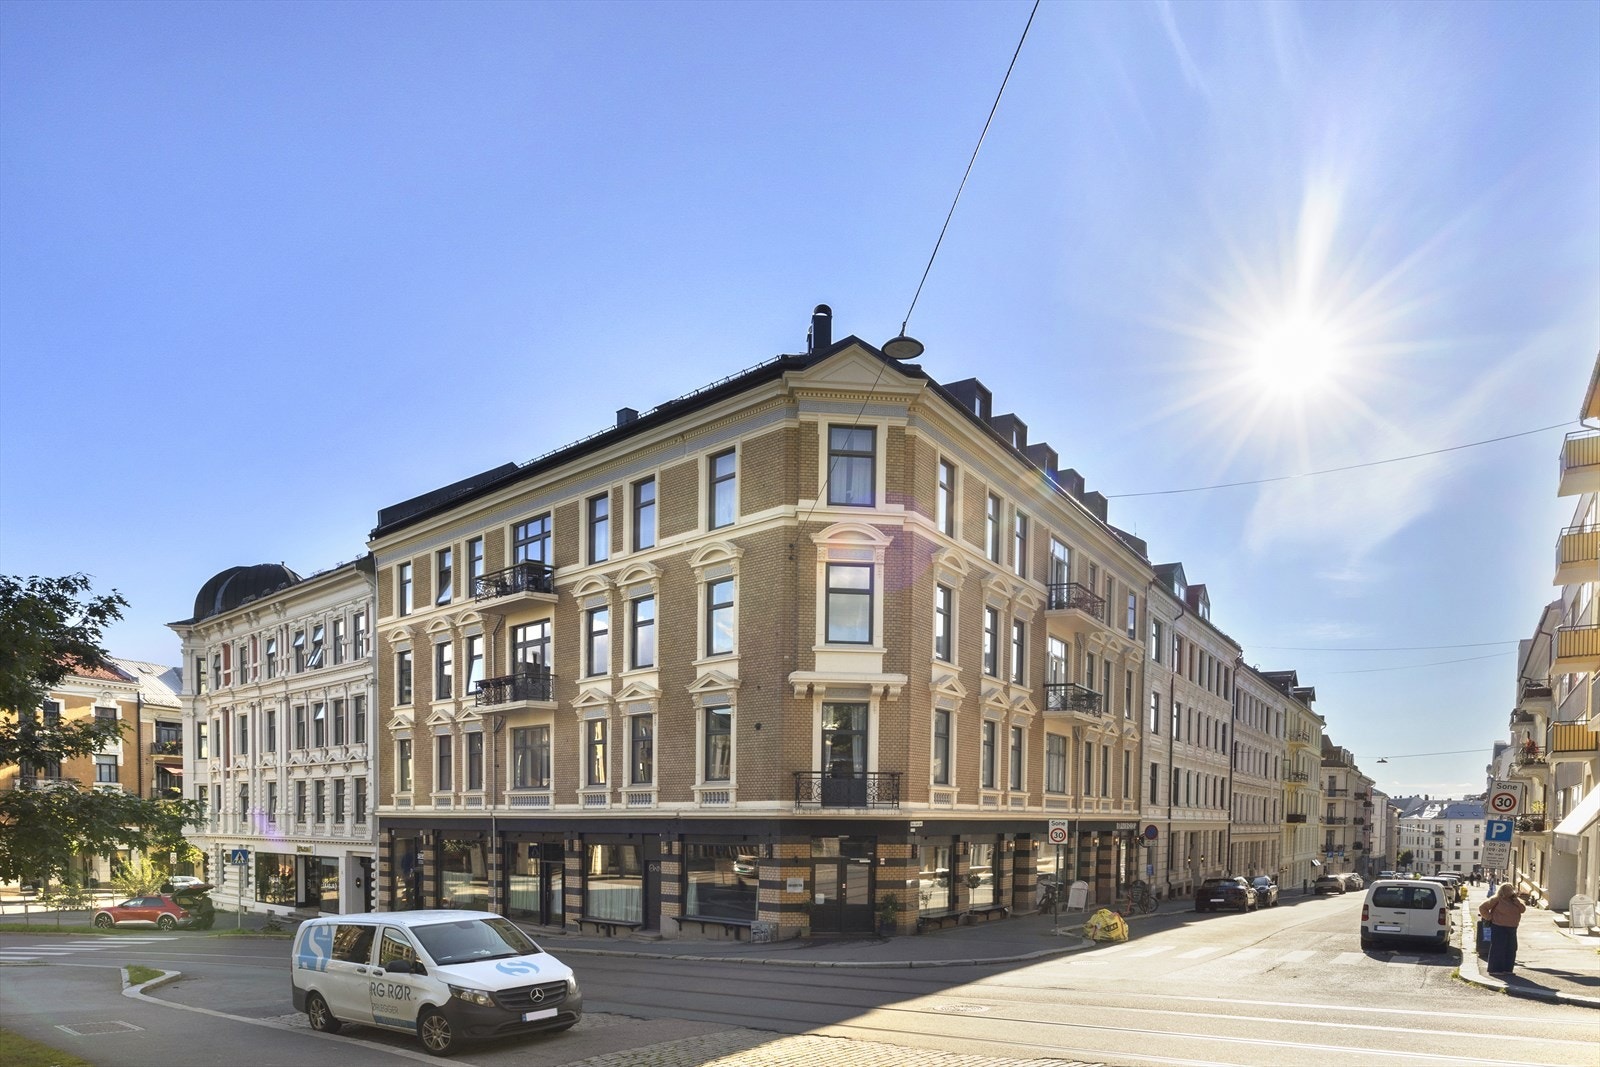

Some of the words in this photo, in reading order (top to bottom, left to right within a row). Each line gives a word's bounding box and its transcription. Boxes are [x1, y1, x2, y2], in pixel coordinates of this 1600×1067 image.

[1497, 782, 1518, 791] Sone
[1496, 797, 1512, 808] 30
[1054, 831, 1064, 839] 30
[1491, 823, 1507, 838] P
[387, 984, 411, 1001] RØR
